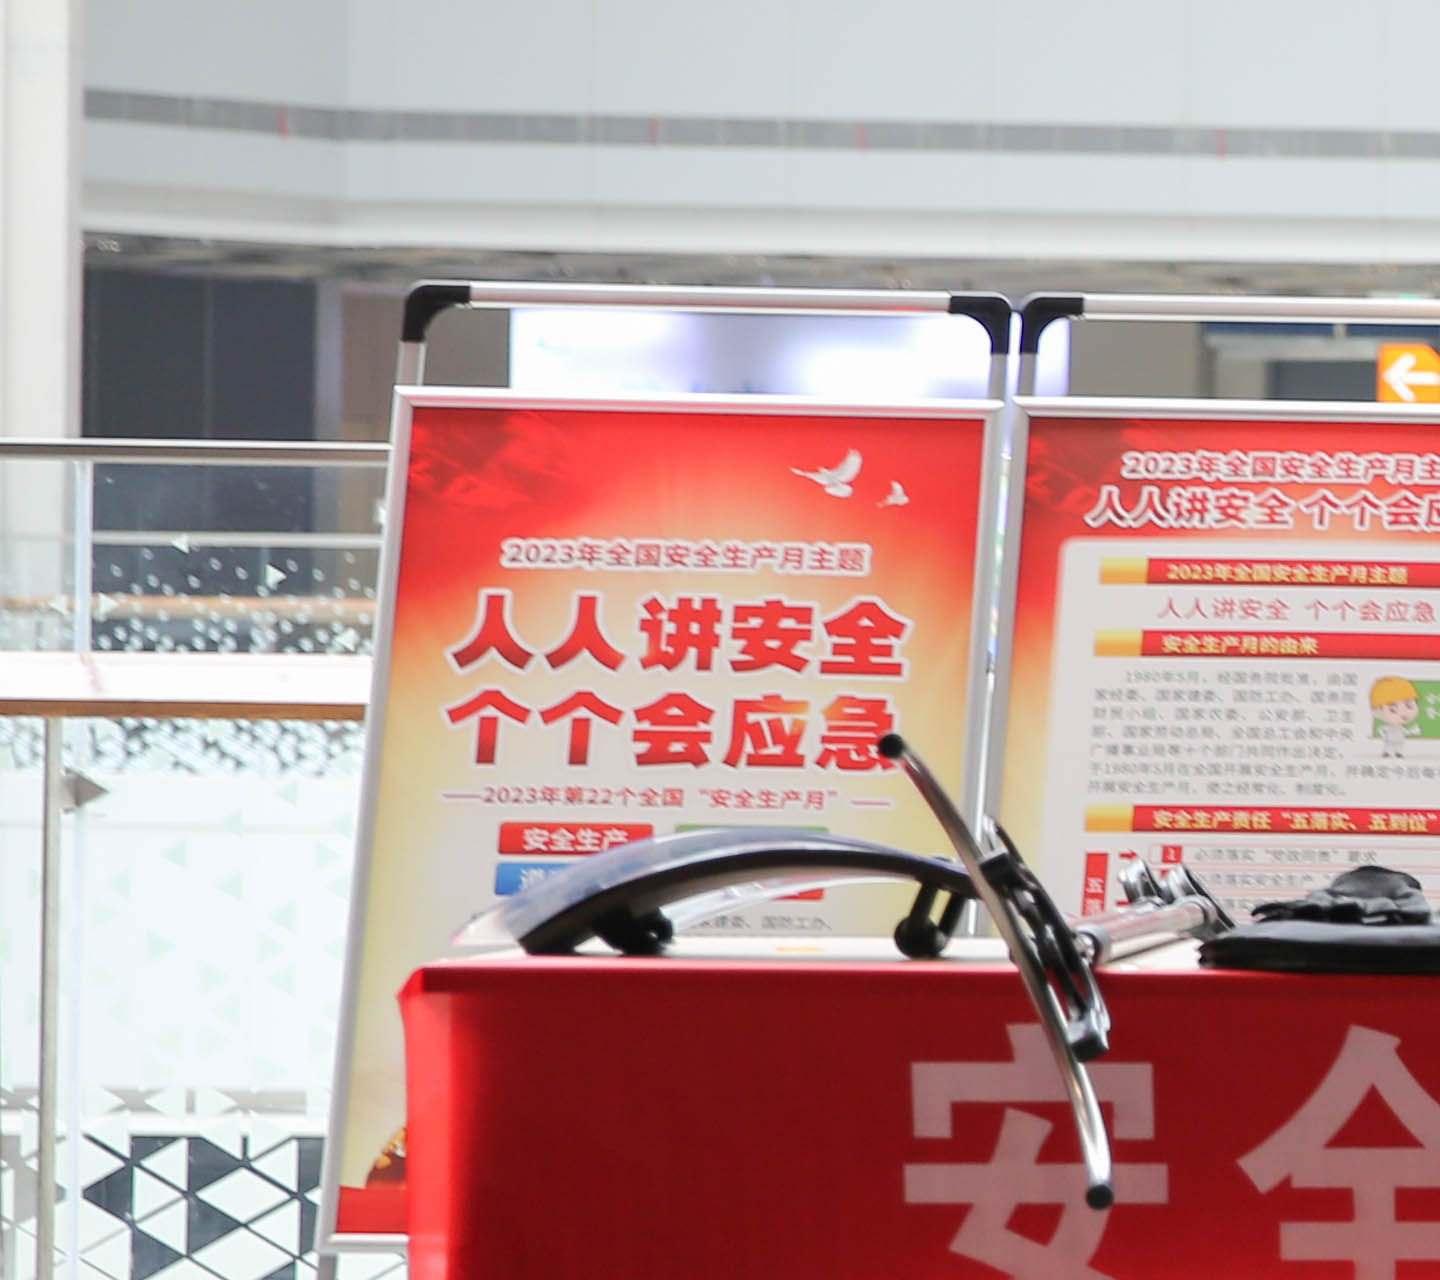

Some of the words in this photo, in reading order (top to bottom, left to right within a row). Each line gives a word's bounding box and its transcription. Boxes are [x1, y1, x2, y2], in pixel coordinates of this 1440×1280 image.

[1086, 487, 1292, 529] 人人讲安全
[507, 540, 870, 575] 2023年全国安全生产月主题
[1166, 562, 1408, 586] 2023年全国安全生产月主题
[1157, 597, 1290, 622] 人人讲安全
[1305, 600, 1437, 624] 个个会应急
[451, 592, 908, 677] 人人讲安全
[1161, 634, 1318, 657] 安全生产月的由来
[446, 690, 899, 771] 个个会应急
[522, 827, 628, 854] 安全生产
